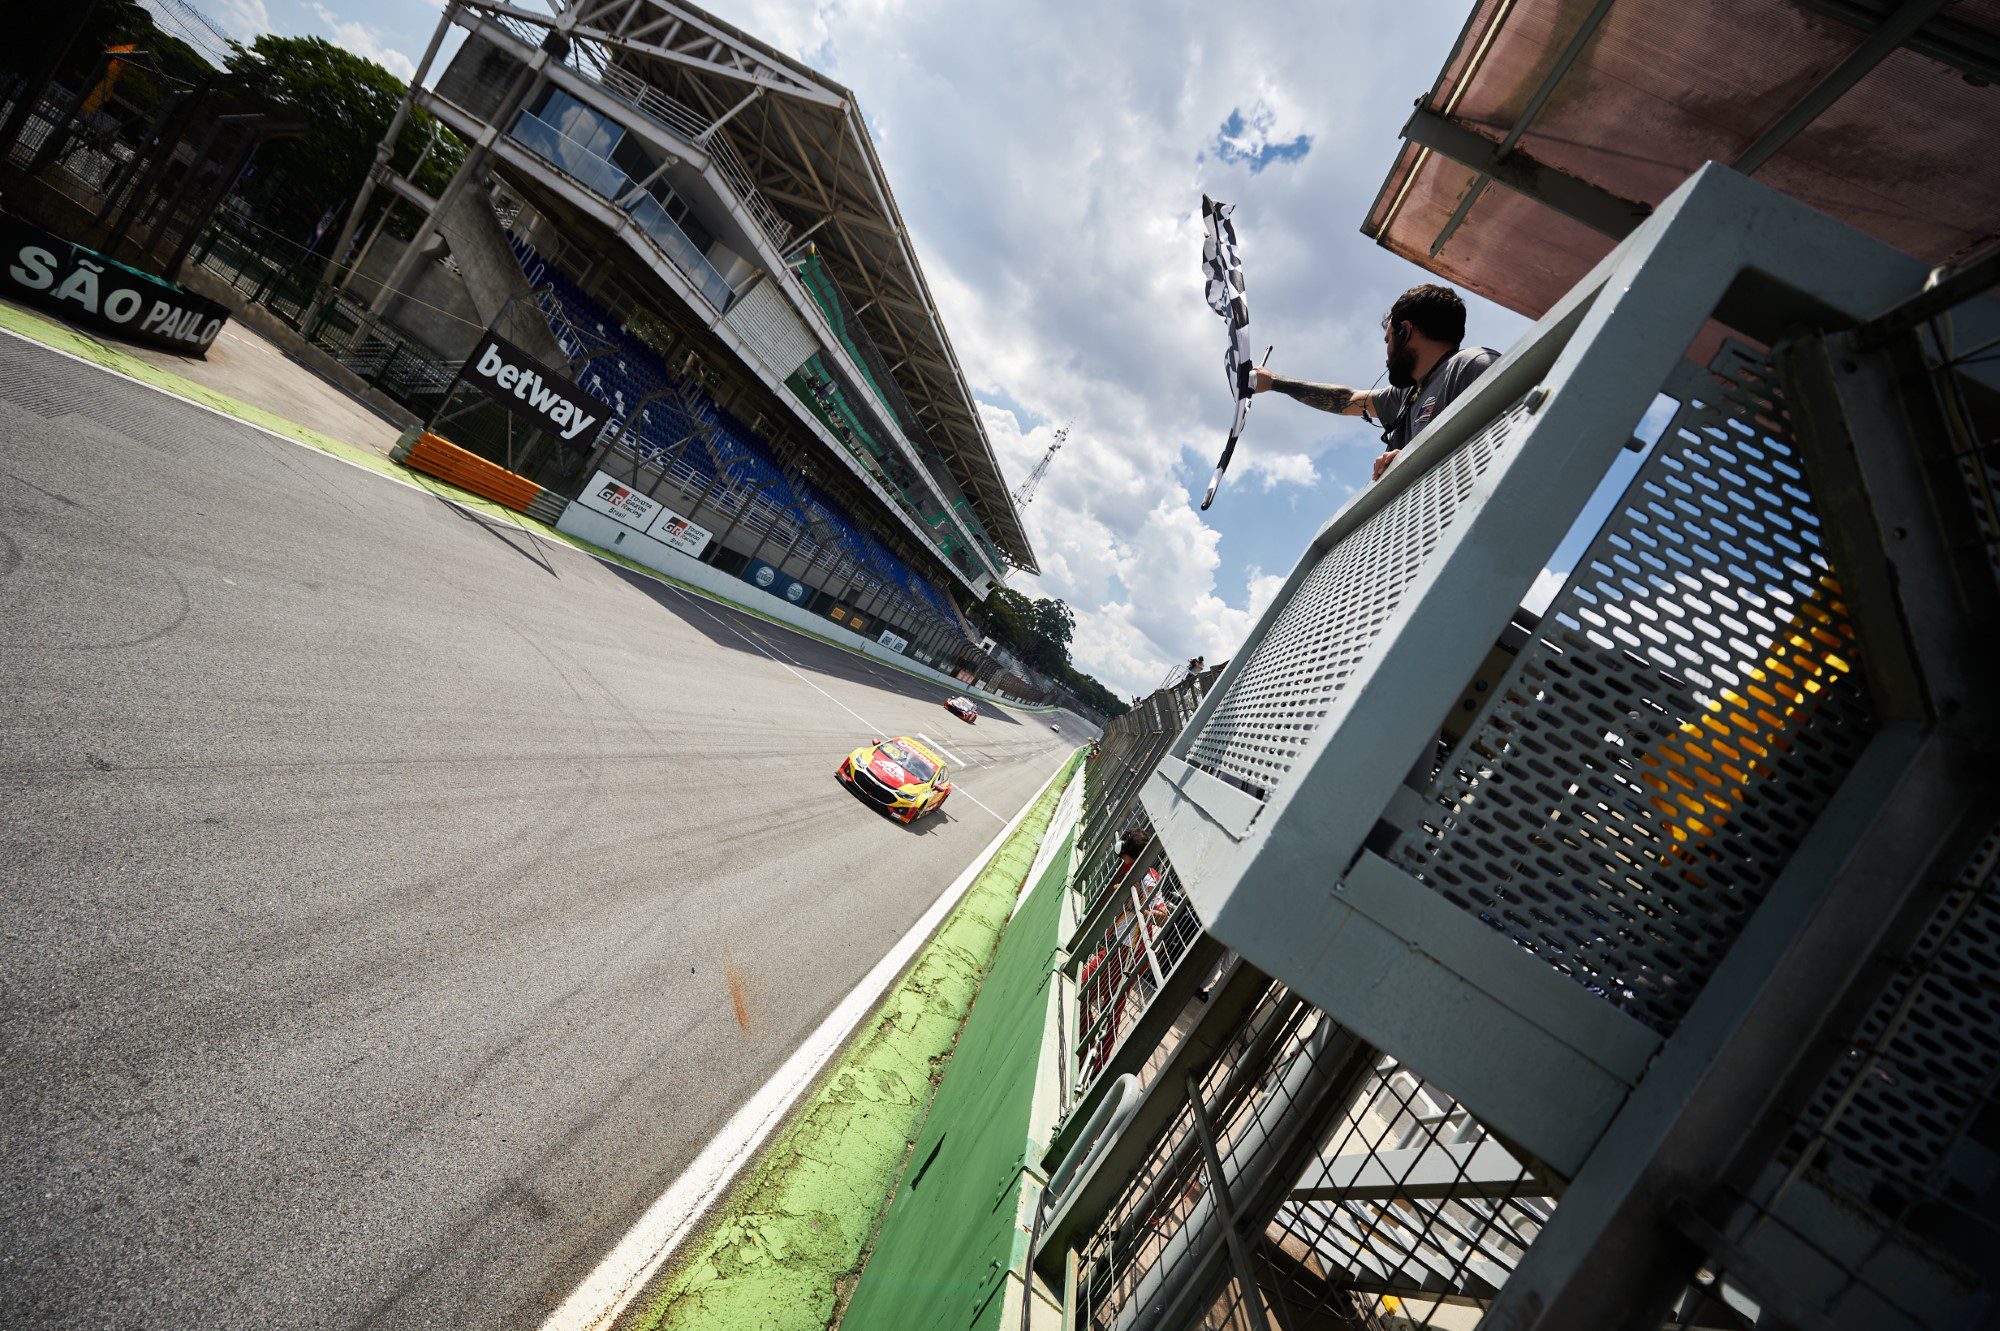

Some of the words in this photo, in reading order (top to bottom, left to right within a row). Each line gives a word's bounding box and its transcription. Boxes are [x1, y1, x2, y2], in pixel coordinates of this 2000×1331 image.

[9, 246, 142, 324] SÃO
[140, 300, 221, 346] PAULO
[475, 342, 597, 440] betway
[630, 494, 652, 509] TOYOTA
[608, 507, 627, 518] Brasil
[620, 503, 642, 519] Racing
